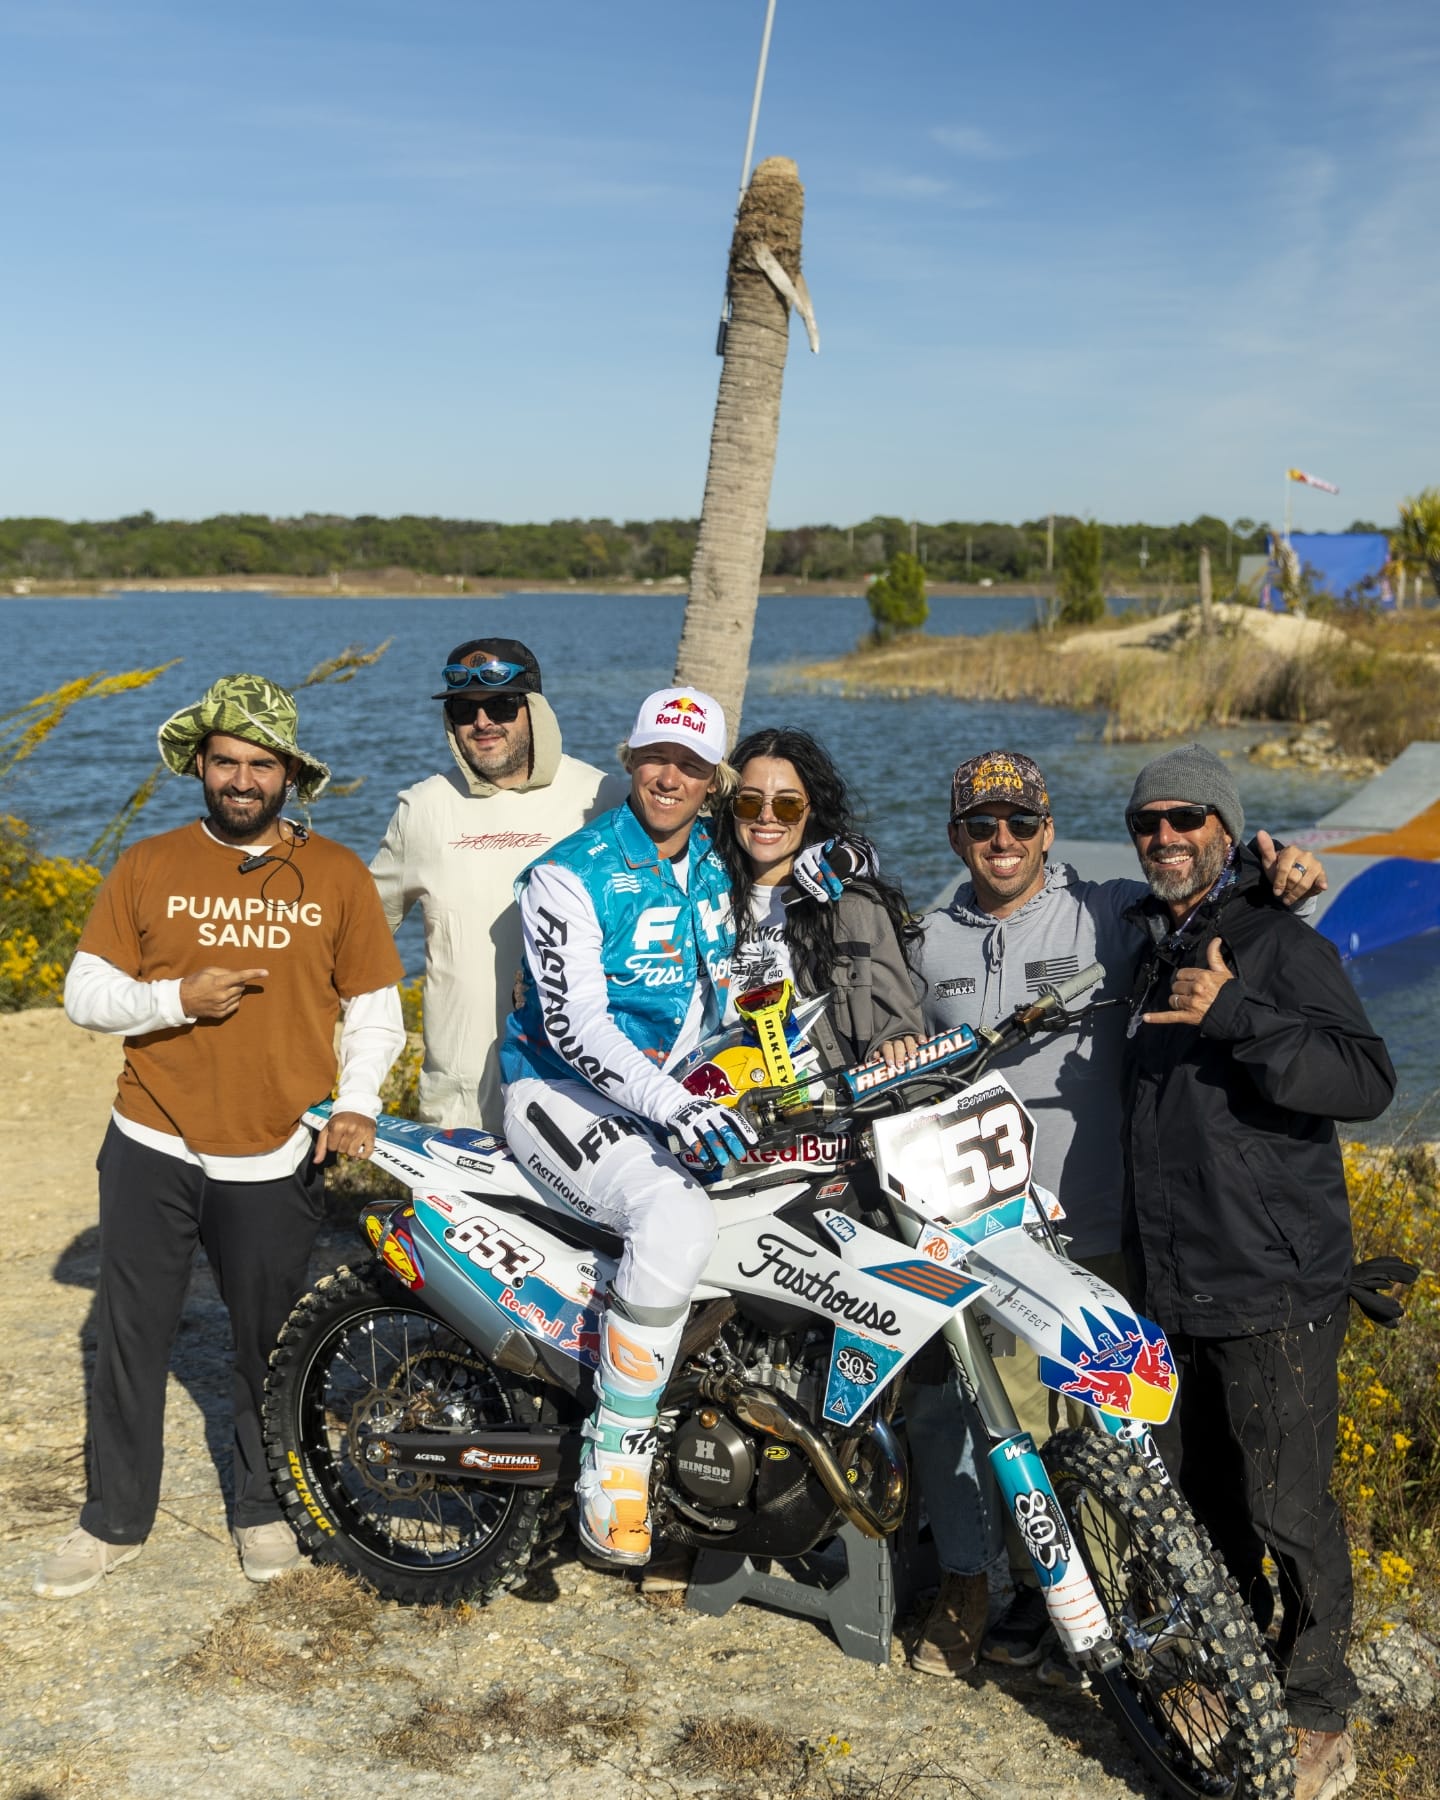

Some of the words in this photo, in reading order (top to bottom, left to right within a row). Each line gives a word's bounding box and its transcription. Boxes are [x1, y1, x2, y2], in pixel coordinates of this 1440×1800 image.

[656, 713, 681, 725] Red
[682, 715, 706, 735] Bull
[167, 895, 323, 927] PUMPING
[198, 923, 291, 949] SAND
[764, 1019, 789, 1084] OAKLEY
[855, 1033, 972, 1093] RENTHAL
[373, 1145, 426, 1178] UNLOP
[741, 1134, 799, 1163] Red
[801, 1134, 850, 1162] Bull
[528, 1153, 597, 1217] FASTHOUSE
[827, 1217, 857, 1242] KTM
[444, 1216, 545, 1287] 653
[580, 1264, 599, 1279] BELL
[738, 1233, 902, 1336] Fasthouse
[498, 1287, 535, 1320] Red
[527, 1307, 566, 1339] Bull
[1009, 1299, 1052, 1331] EFFECT
[836, 1350, 878, 1384] 805
[679, 1459, 731, 1478] HINSON
[287, 1450, 333, 1531] DUNLOP
[1015, 1490, 1070, 1570] 805
